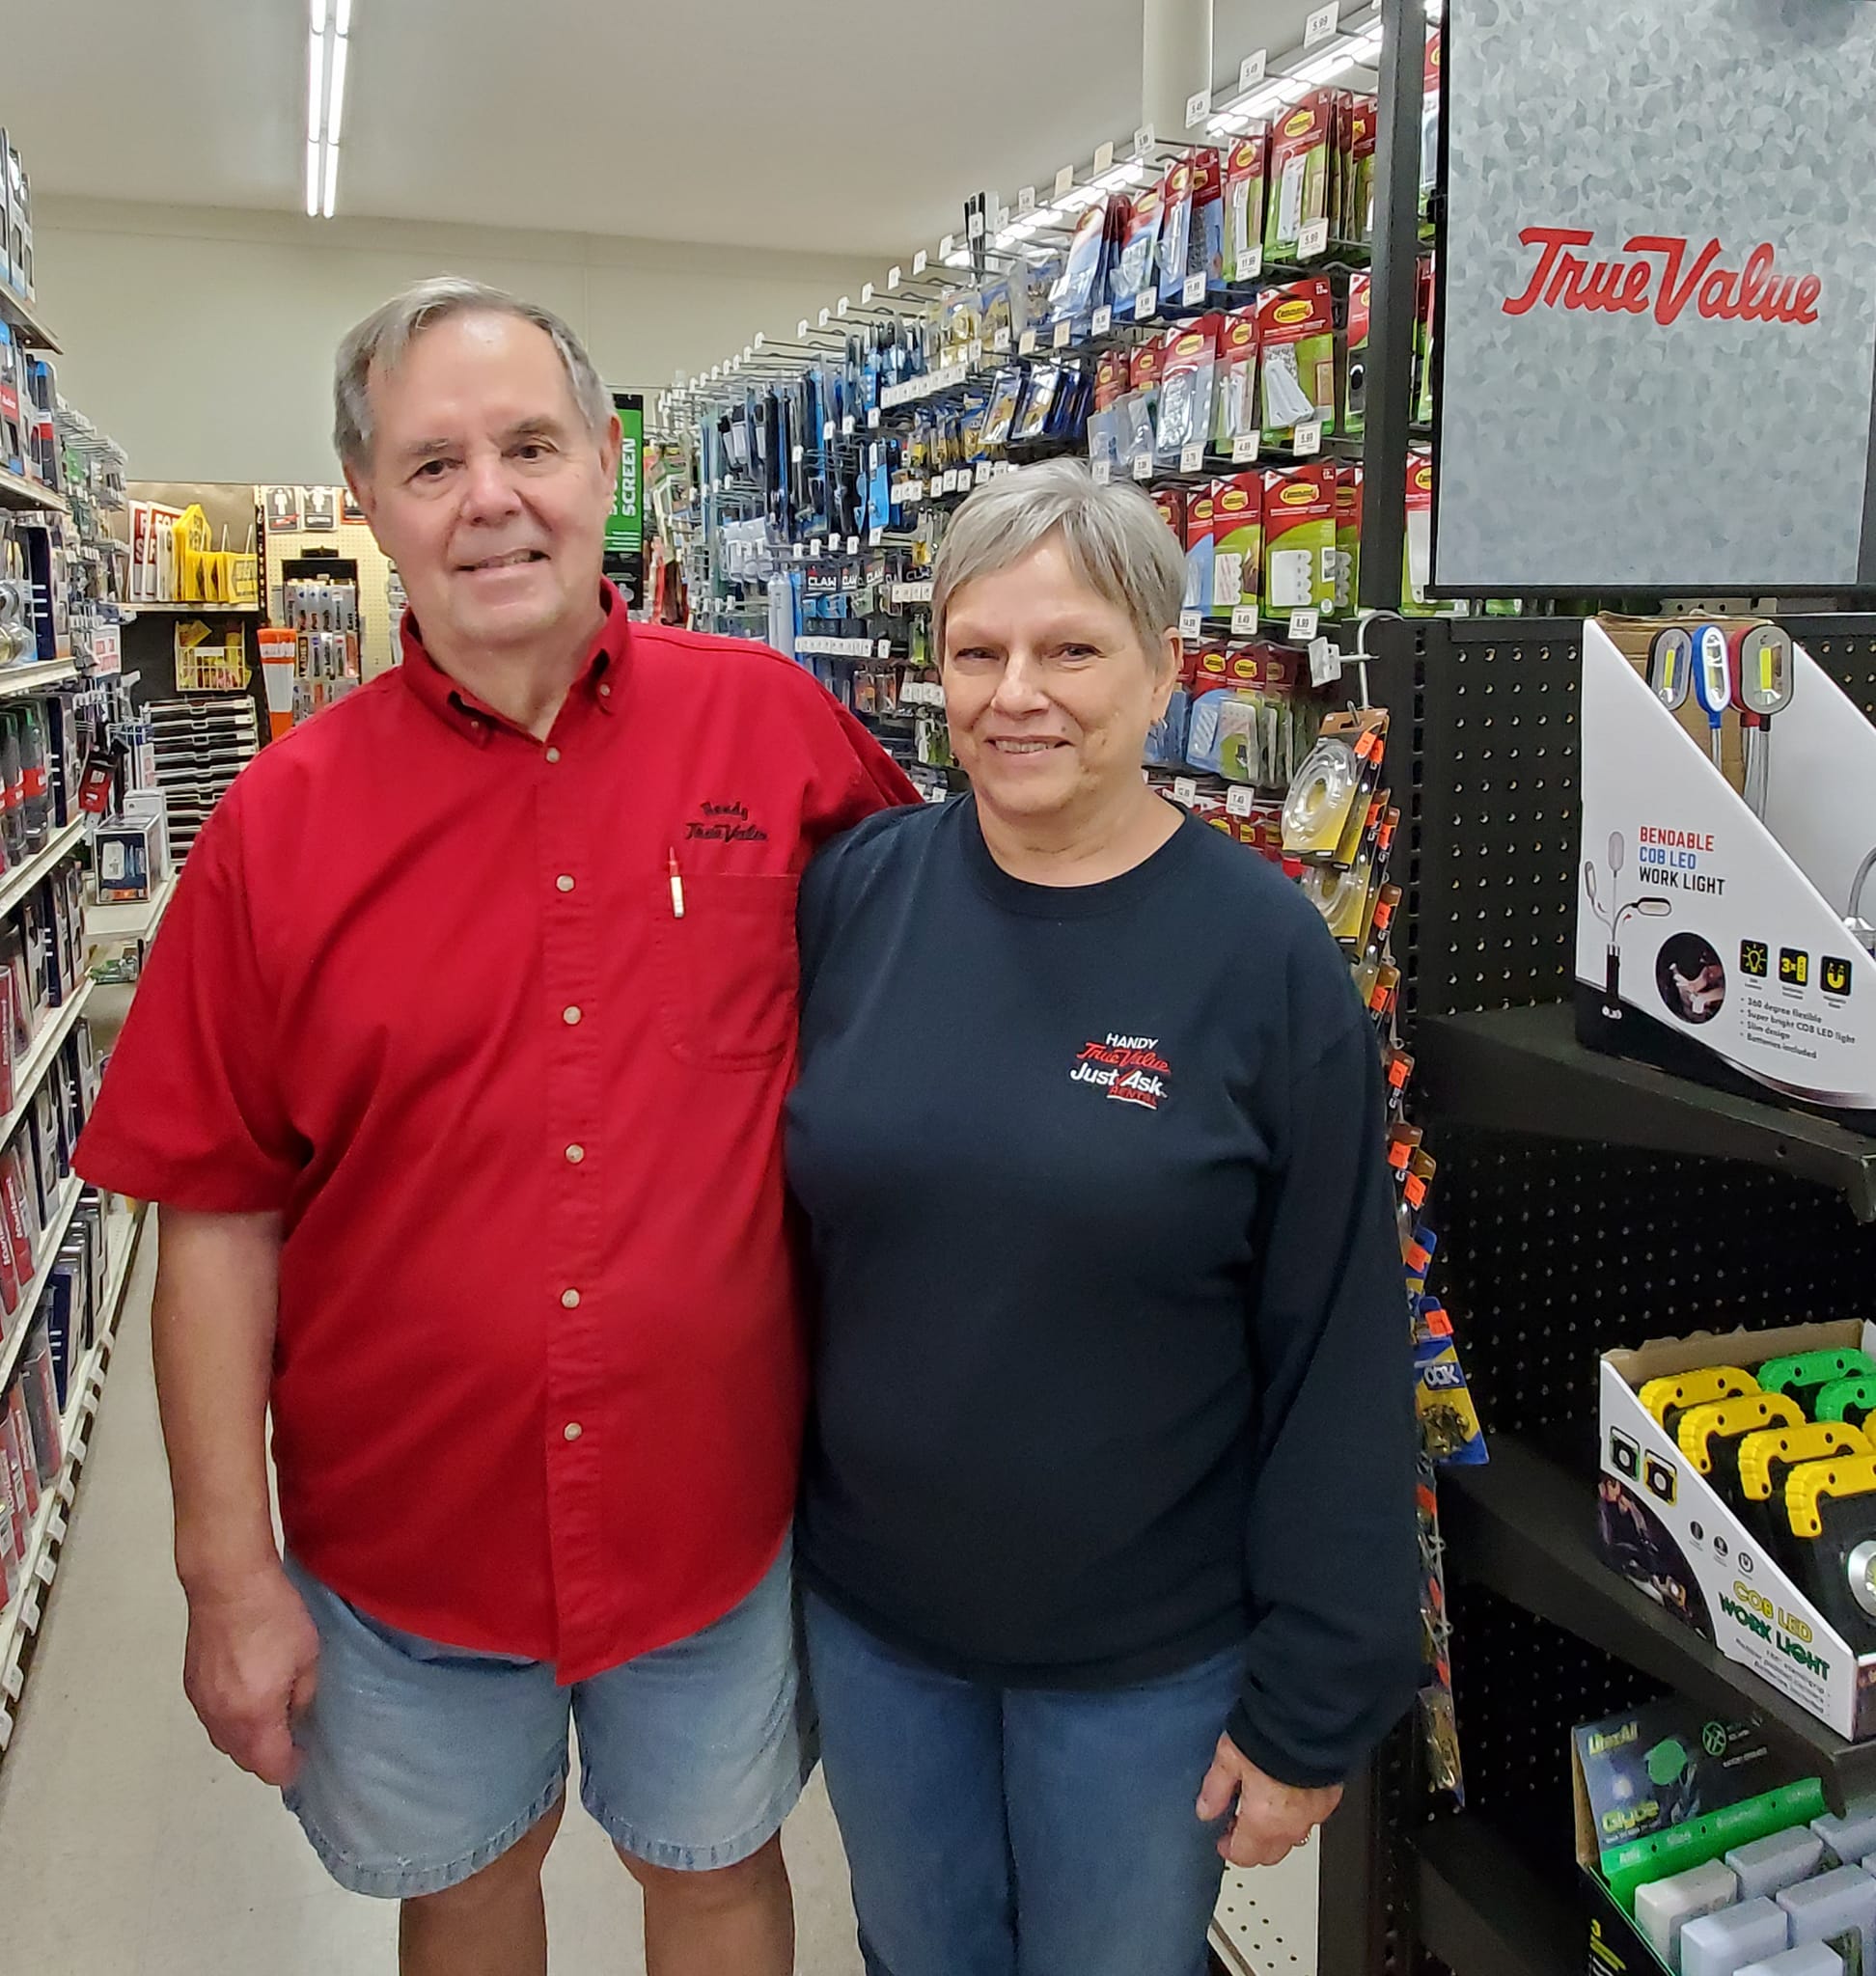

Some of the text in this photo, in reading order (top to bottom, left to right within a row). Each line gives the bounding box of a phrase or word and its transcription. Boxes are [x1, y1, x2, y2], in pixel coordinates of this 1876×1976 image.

[621, 437, 637, 517] SCREEN
[808, 576, 838, 587] CLAW
[1640, 826, 1715, 852] BENDABLE
[1640, 846, 1697, 869] COB LED
[1640, 865, 1725, 895] WORK LIGHT
[1747, 1008, 1769, 1023] Super
[1770, 1014, 1795, 1029] bright
[1816, 1027, 1835, 1038] LED
[1835, 1031, 1856, 1044] light
[1764, 1002, 1791, 1016] degree
[1792, 1008, 1823, 1024] flexible
[1106, 1032, 1159, 1050] HANDY
[1747, 1021, 1791, 1040] Slim design
[1069, 1062, 1168, 1098] Just Ask
[1733, 1579, 1813, 1644] COB LED
[1718, 1591, 1831, 1681] WORK LIGHT
